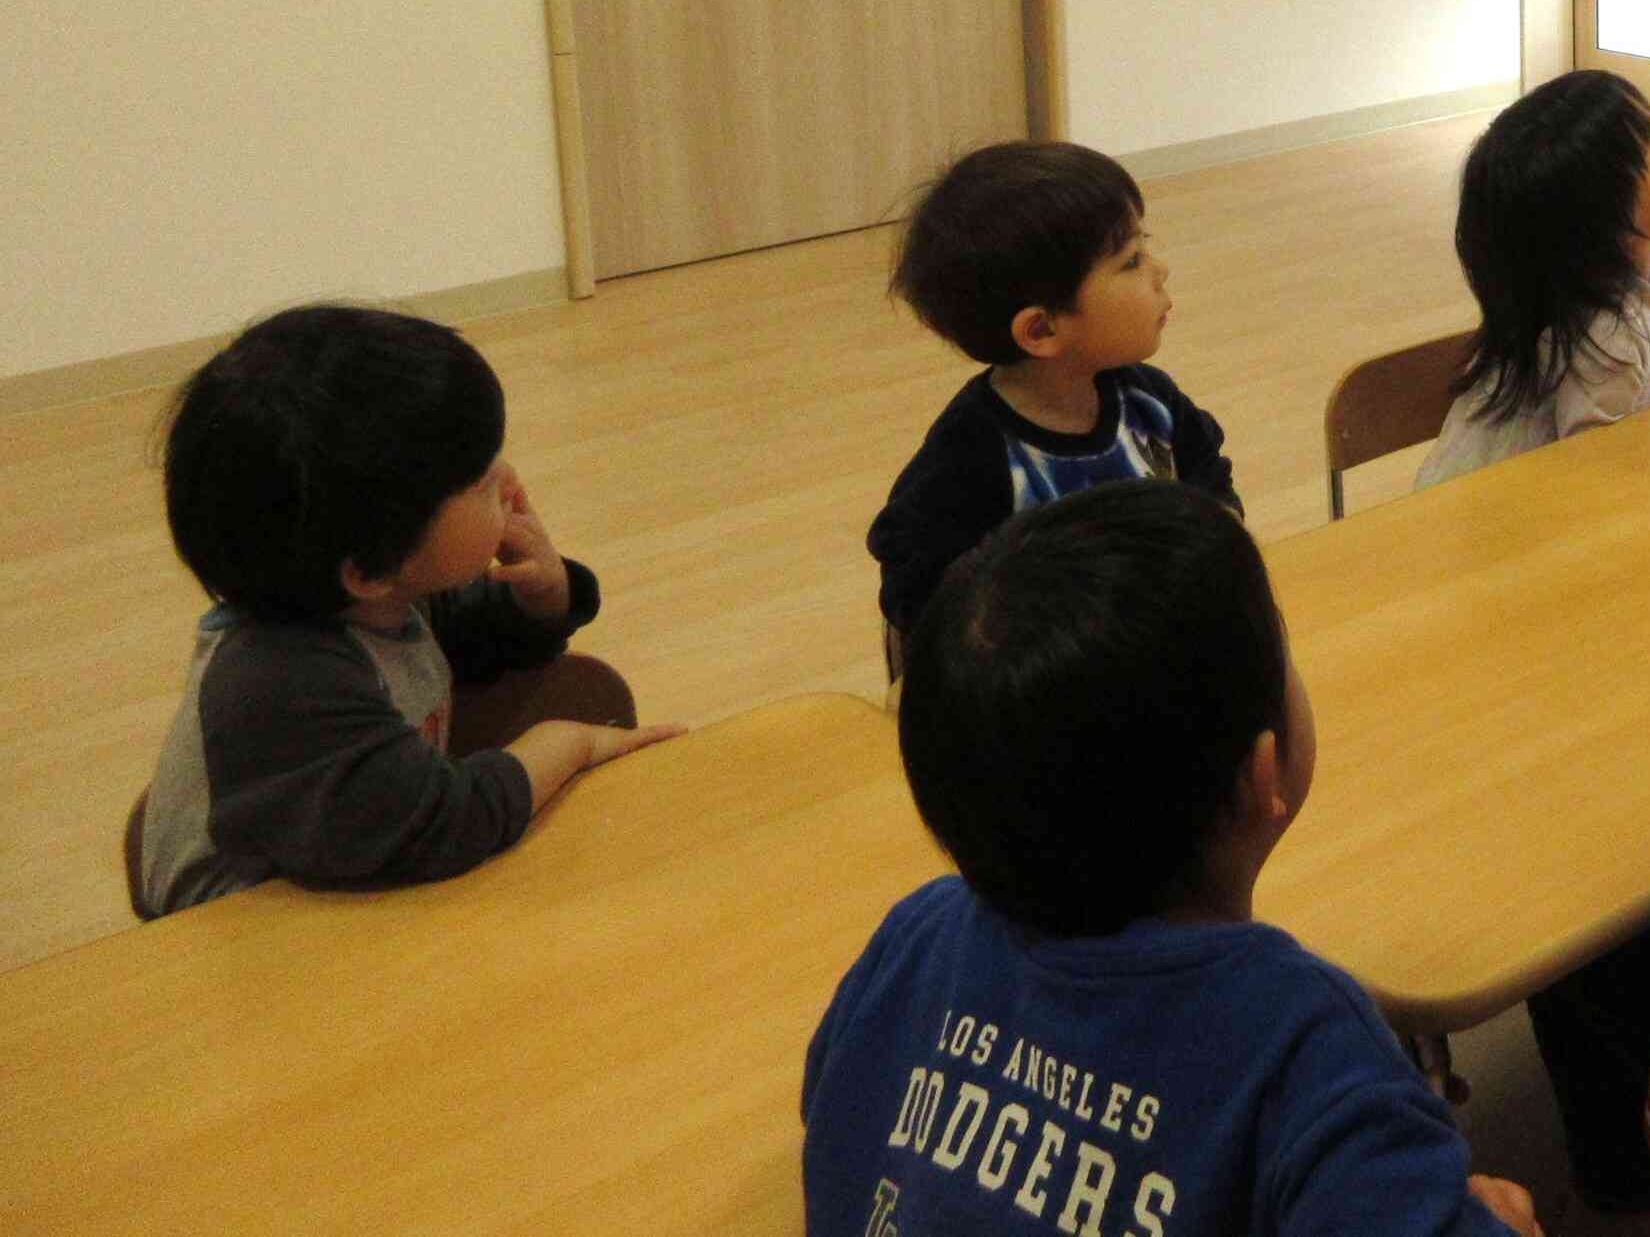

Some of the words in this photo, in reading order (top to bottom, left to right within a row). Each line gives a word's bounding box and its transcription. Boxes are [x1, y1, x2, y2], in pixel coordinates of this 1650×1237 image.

[888, 1066, 1177, 1237] DODGERS
[936, 1009, 999, 1066] LOS
[1002, 1037, 1161, 1142] ANGELES
